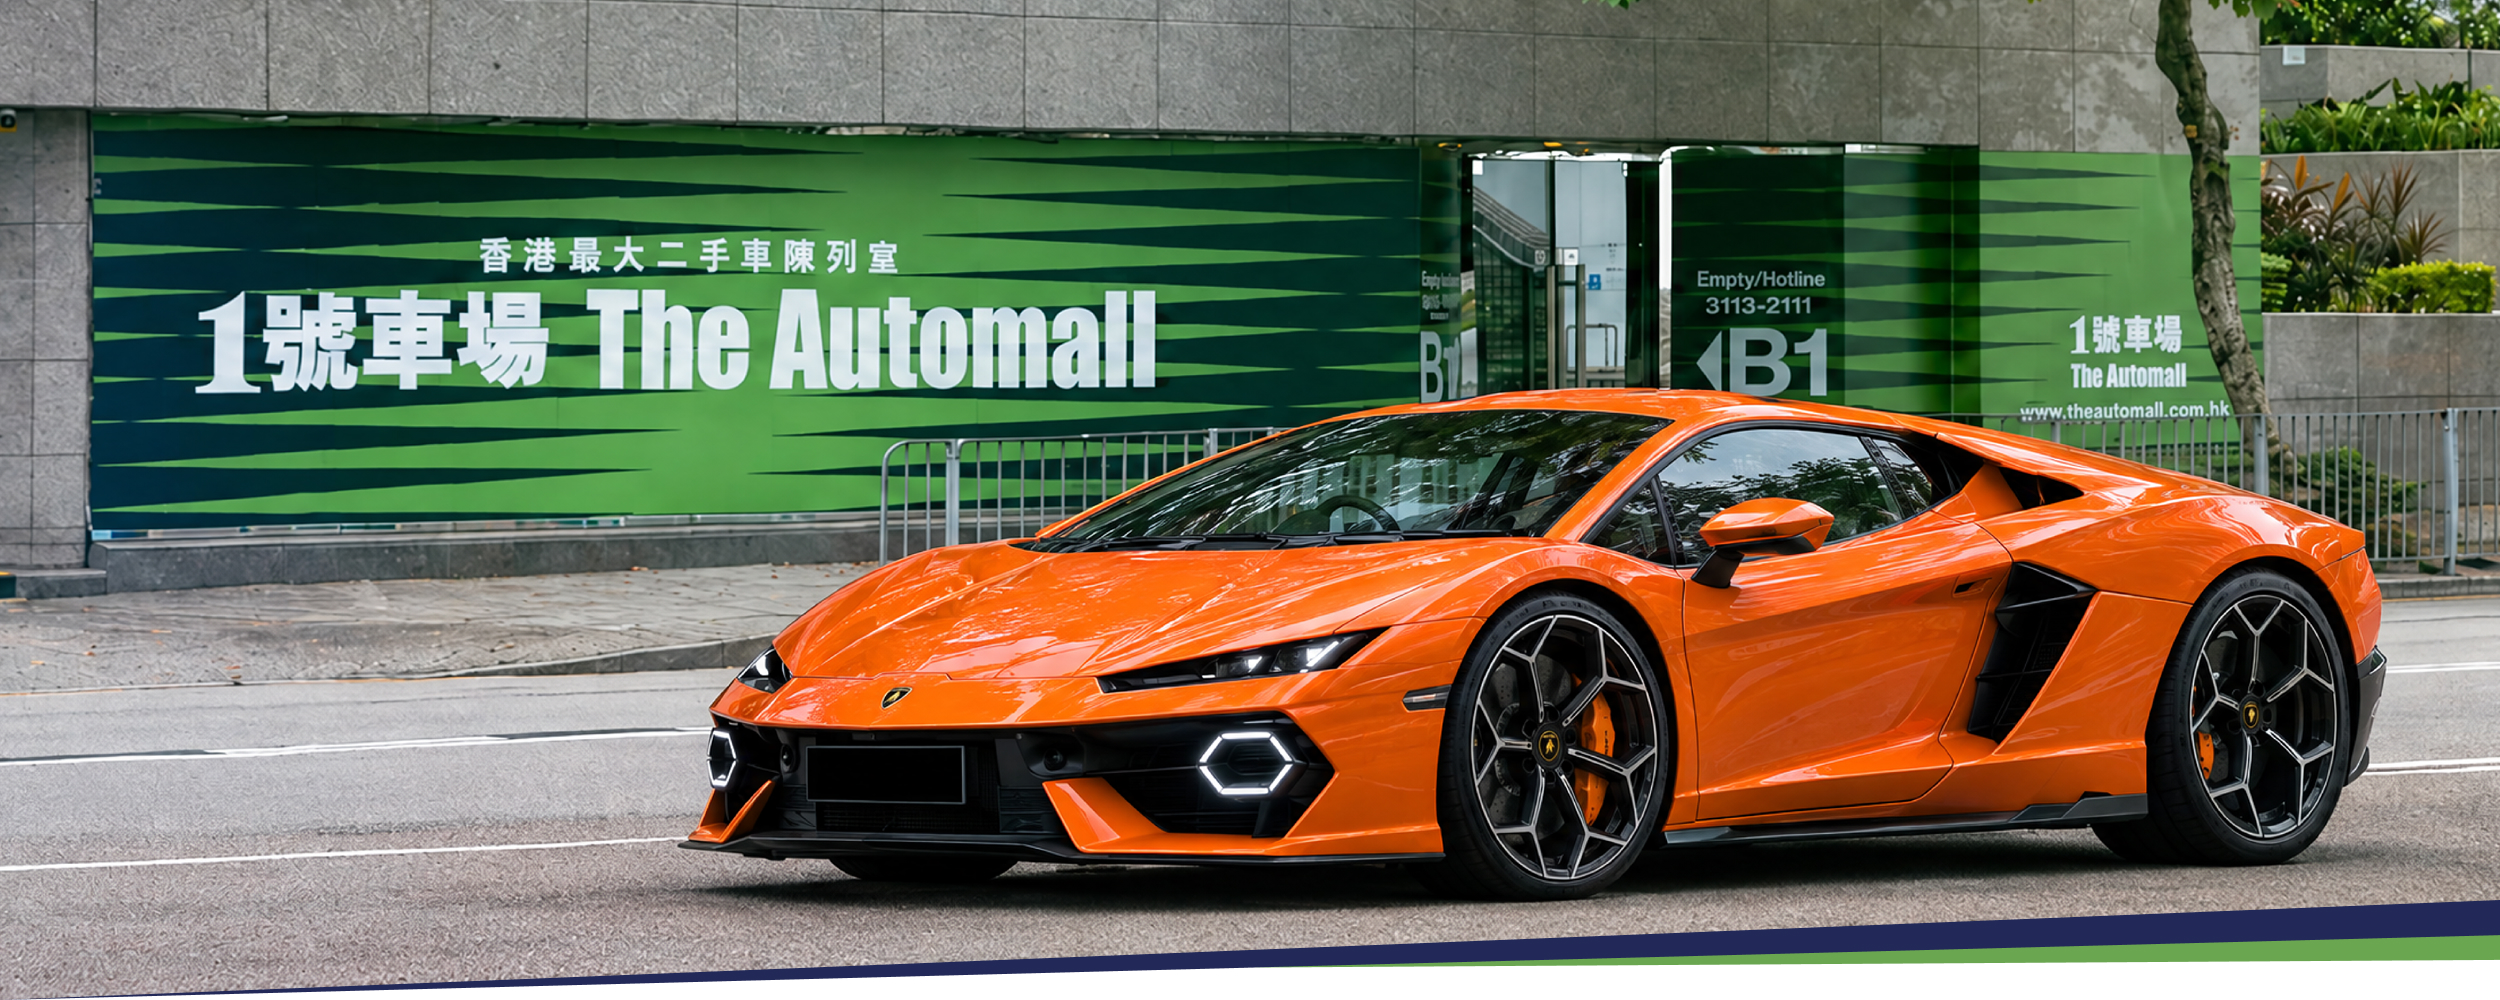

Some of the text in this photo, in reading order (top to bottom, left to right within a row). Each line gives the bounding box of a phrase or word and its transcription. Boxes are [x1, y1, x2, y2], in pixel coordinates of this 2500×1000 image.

[479, 236, 899, 274] 香港最大二手車陳列室
[1697, 270, 1826, 291] Empty/Hotline
[1705, 296, 1811, 315] 3113-2111
[195, 288, 1157, 394] 1號車場 The Automall
[2069, 315, 2183, 354] 1號車場
[1729, 327, 1827, 397] B1
[2070, 362, 2187, 388] The Automall
[2020, 400, 2230, 422] www.theautomall.com.hk
